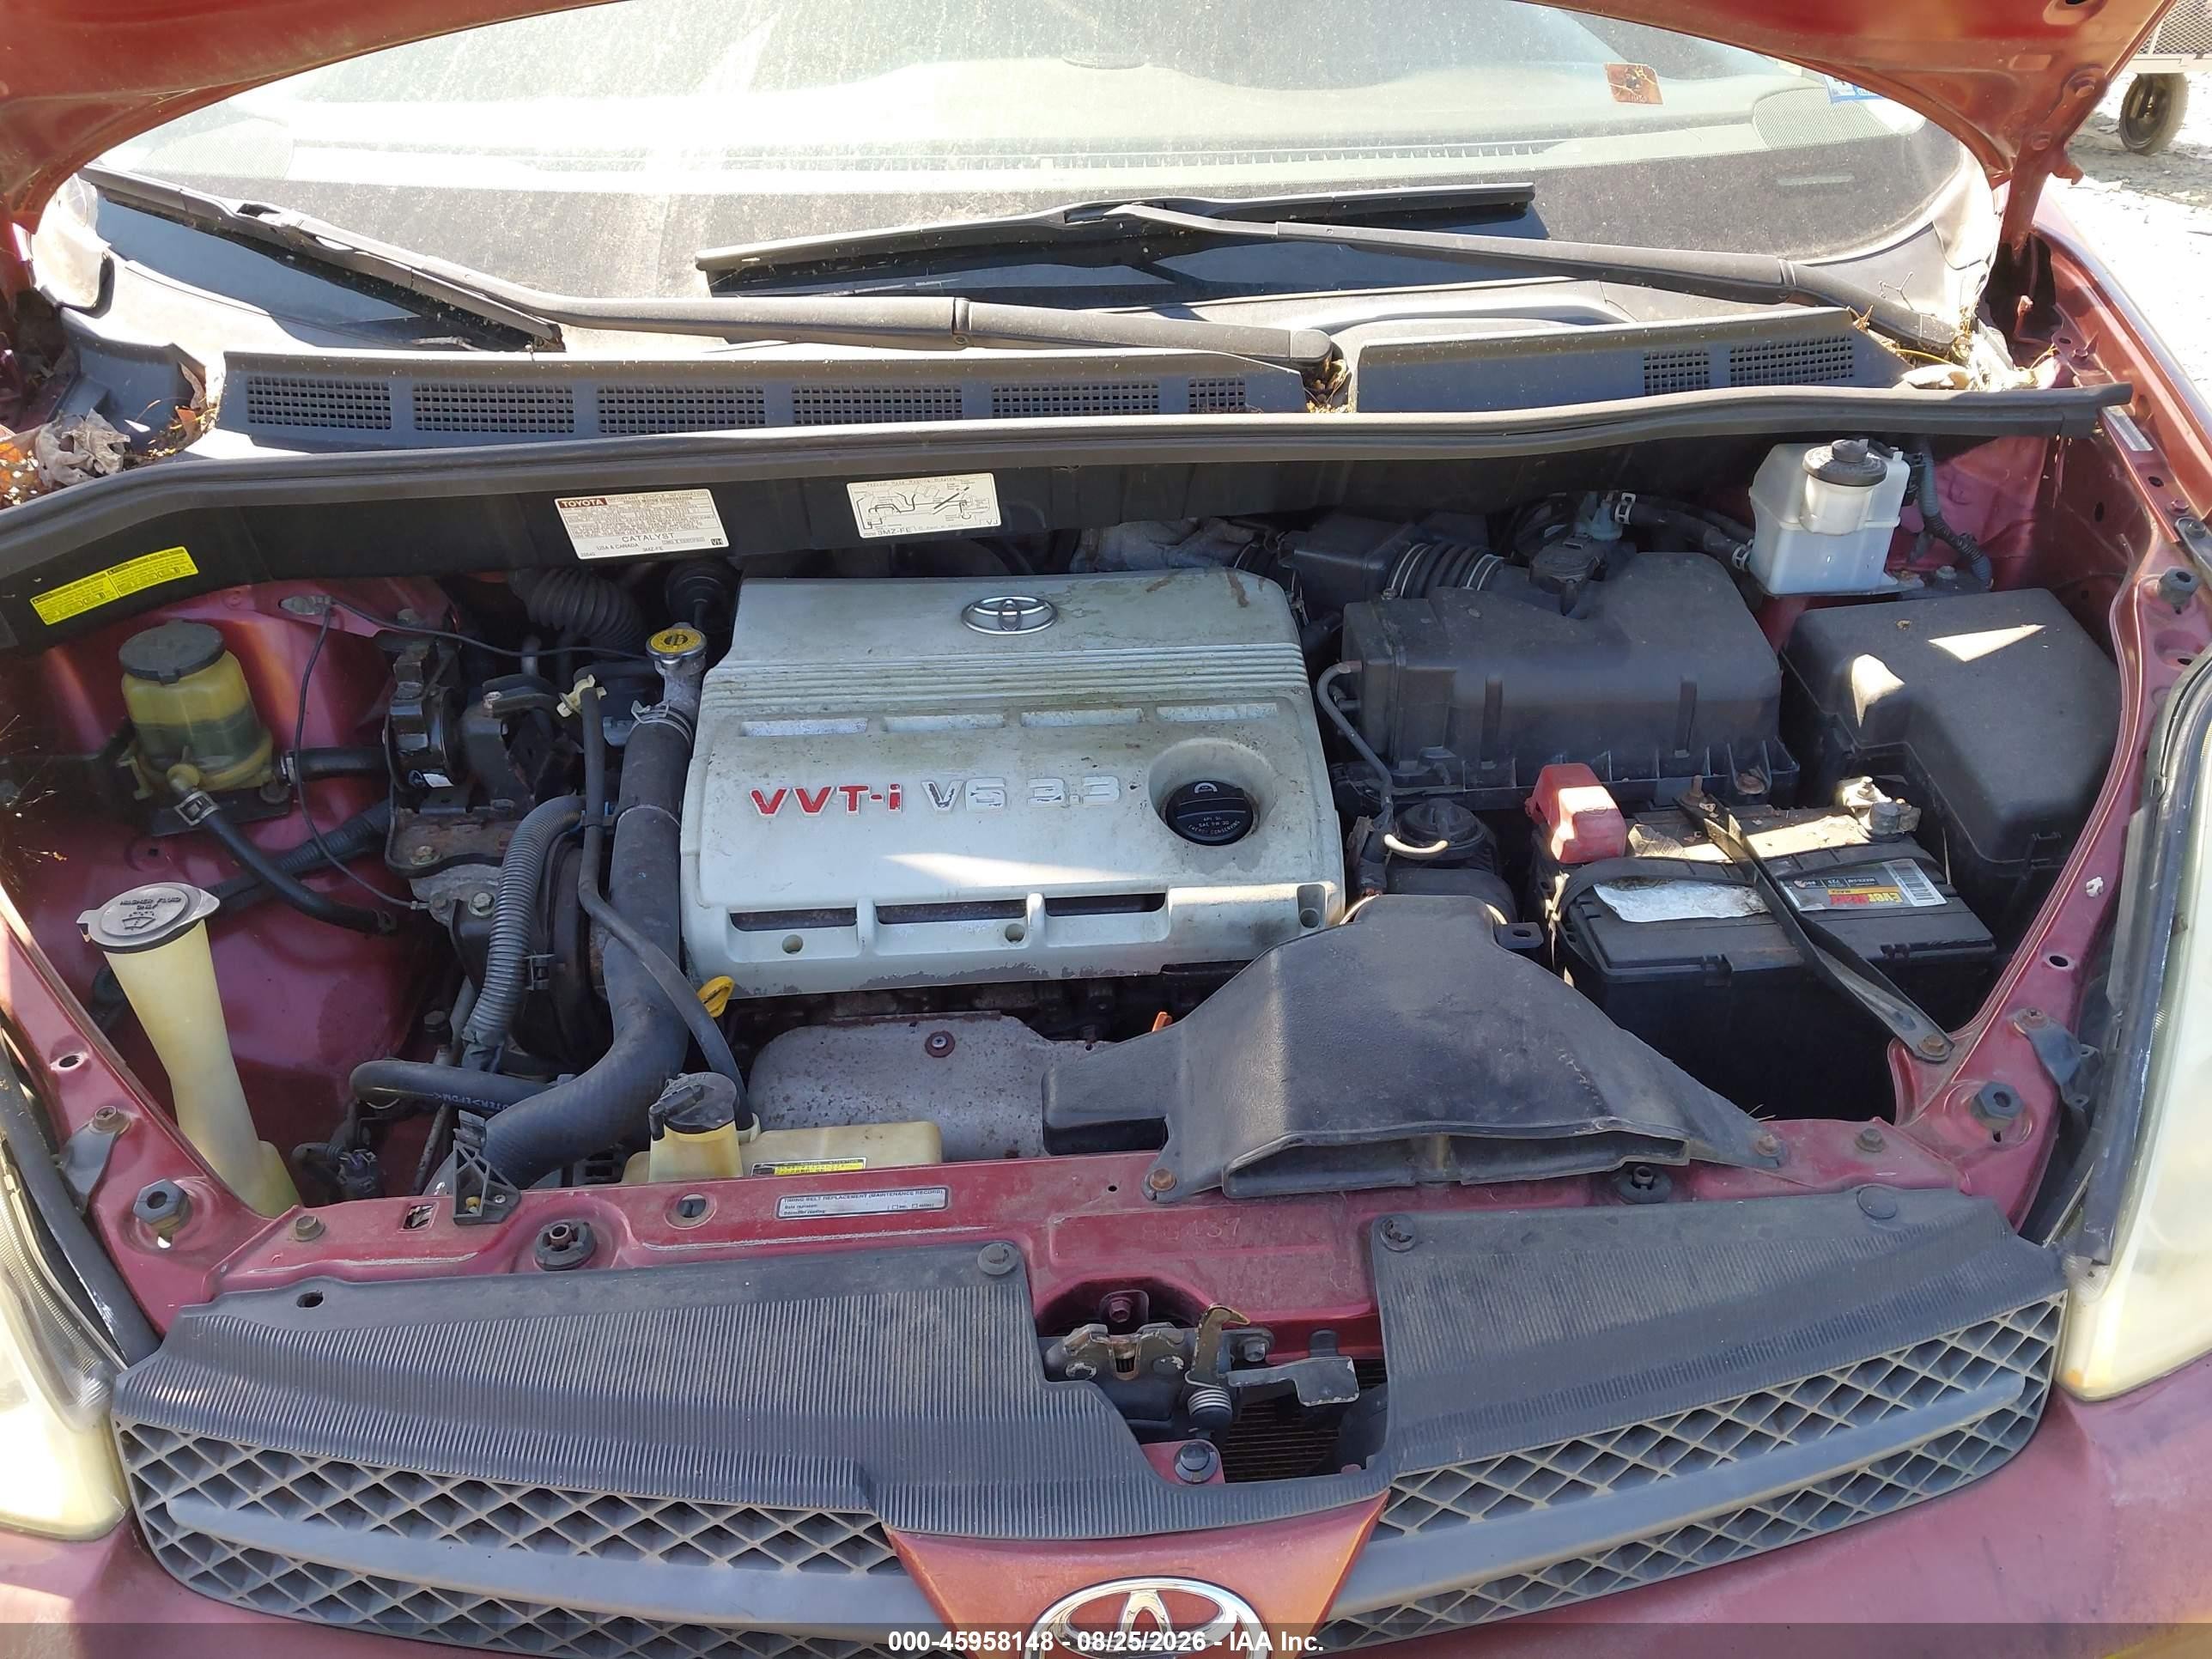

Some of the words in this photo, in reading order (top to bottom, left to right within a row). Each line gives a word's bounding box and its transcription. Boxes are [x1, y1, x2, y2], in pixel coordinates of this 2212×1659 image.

[560, 500, 604, 508] TOYOTA
[878, 527, 913, 536] 3MZ-FE
[622, 533, 675, 543] CATALYST
[749, 783, 902, 817] VVT-i
[921, 776, 1007, 812] V6
[1026, 775, 1121, 806] 3.3
